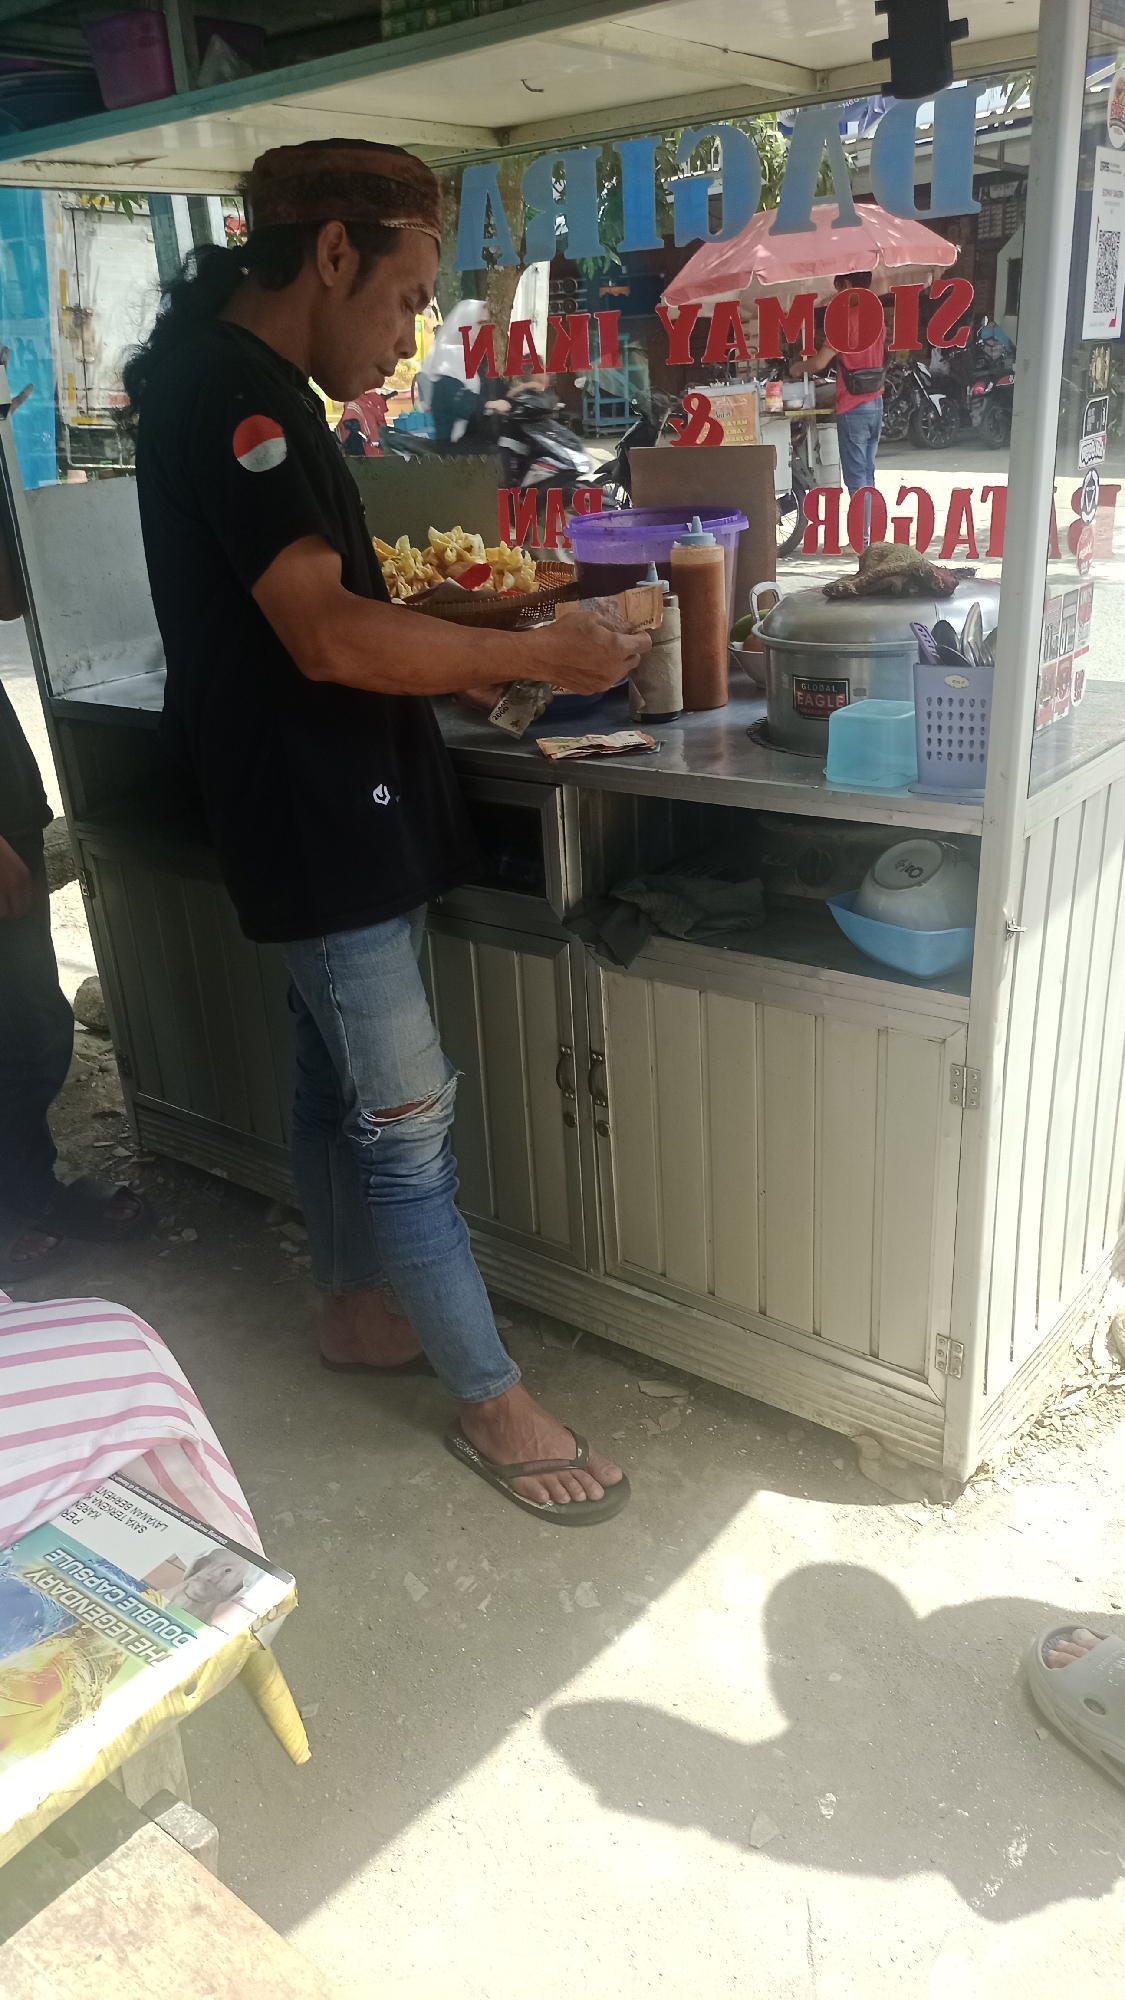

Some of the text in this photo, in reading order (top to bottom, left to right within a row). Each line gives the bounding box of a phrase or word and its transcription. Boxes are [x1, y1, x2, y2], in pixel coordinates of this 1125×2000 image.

[801, 682, 838, 693] GLOBAL
[797, 691, 845, 708] EAGLE
[491, 705, 510, 721] 2000
[90, 1496, 127, 1521] TERKENA
[130, 1506, 168, 1531] LAYANAN
[124, 1516, 147, 1533] SAYA
[24, 1568, 138, 1645] LEGENDARY
[44, 1547, 193, 1648] DOUBLE CAPSULE
